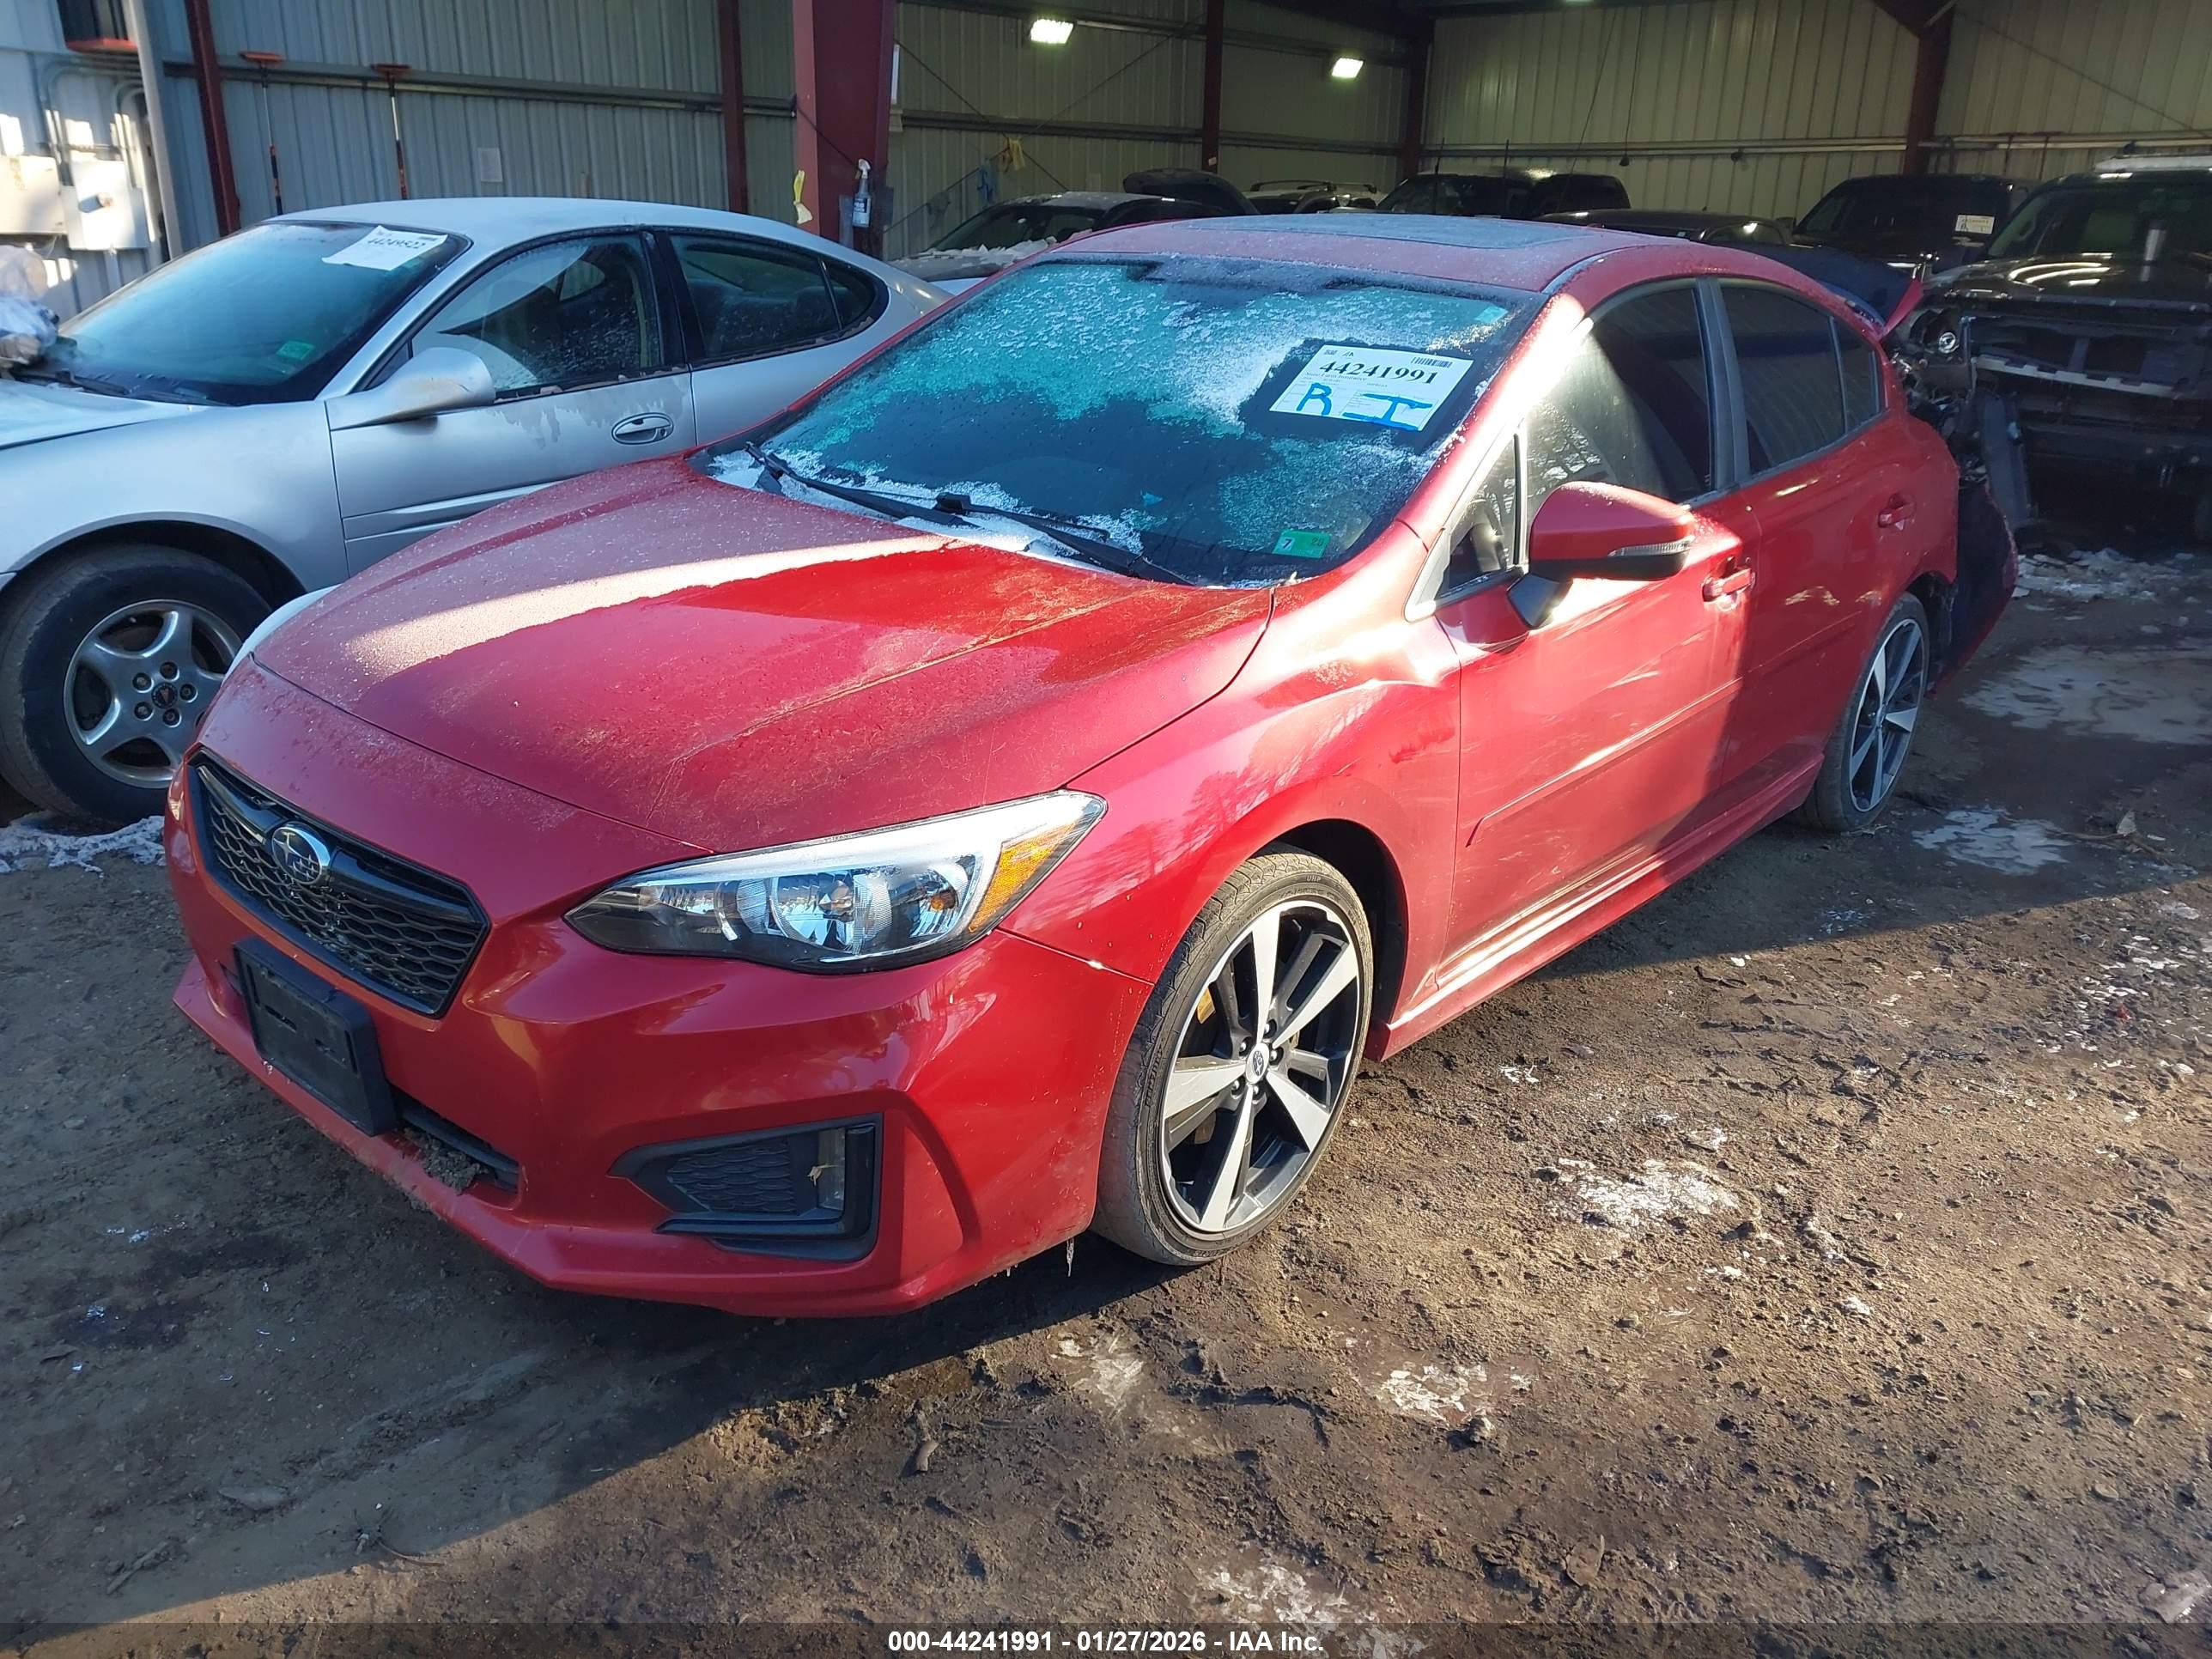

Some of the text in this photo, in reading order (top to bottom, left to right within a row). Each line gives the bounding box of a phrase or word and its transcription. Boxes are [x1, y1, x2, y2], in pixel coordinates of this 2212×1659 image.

[1320, 361, 1438, 385] 44241991
[1296, 382, 1332, 416] R
[1283, 538, 1292, 549] 7
